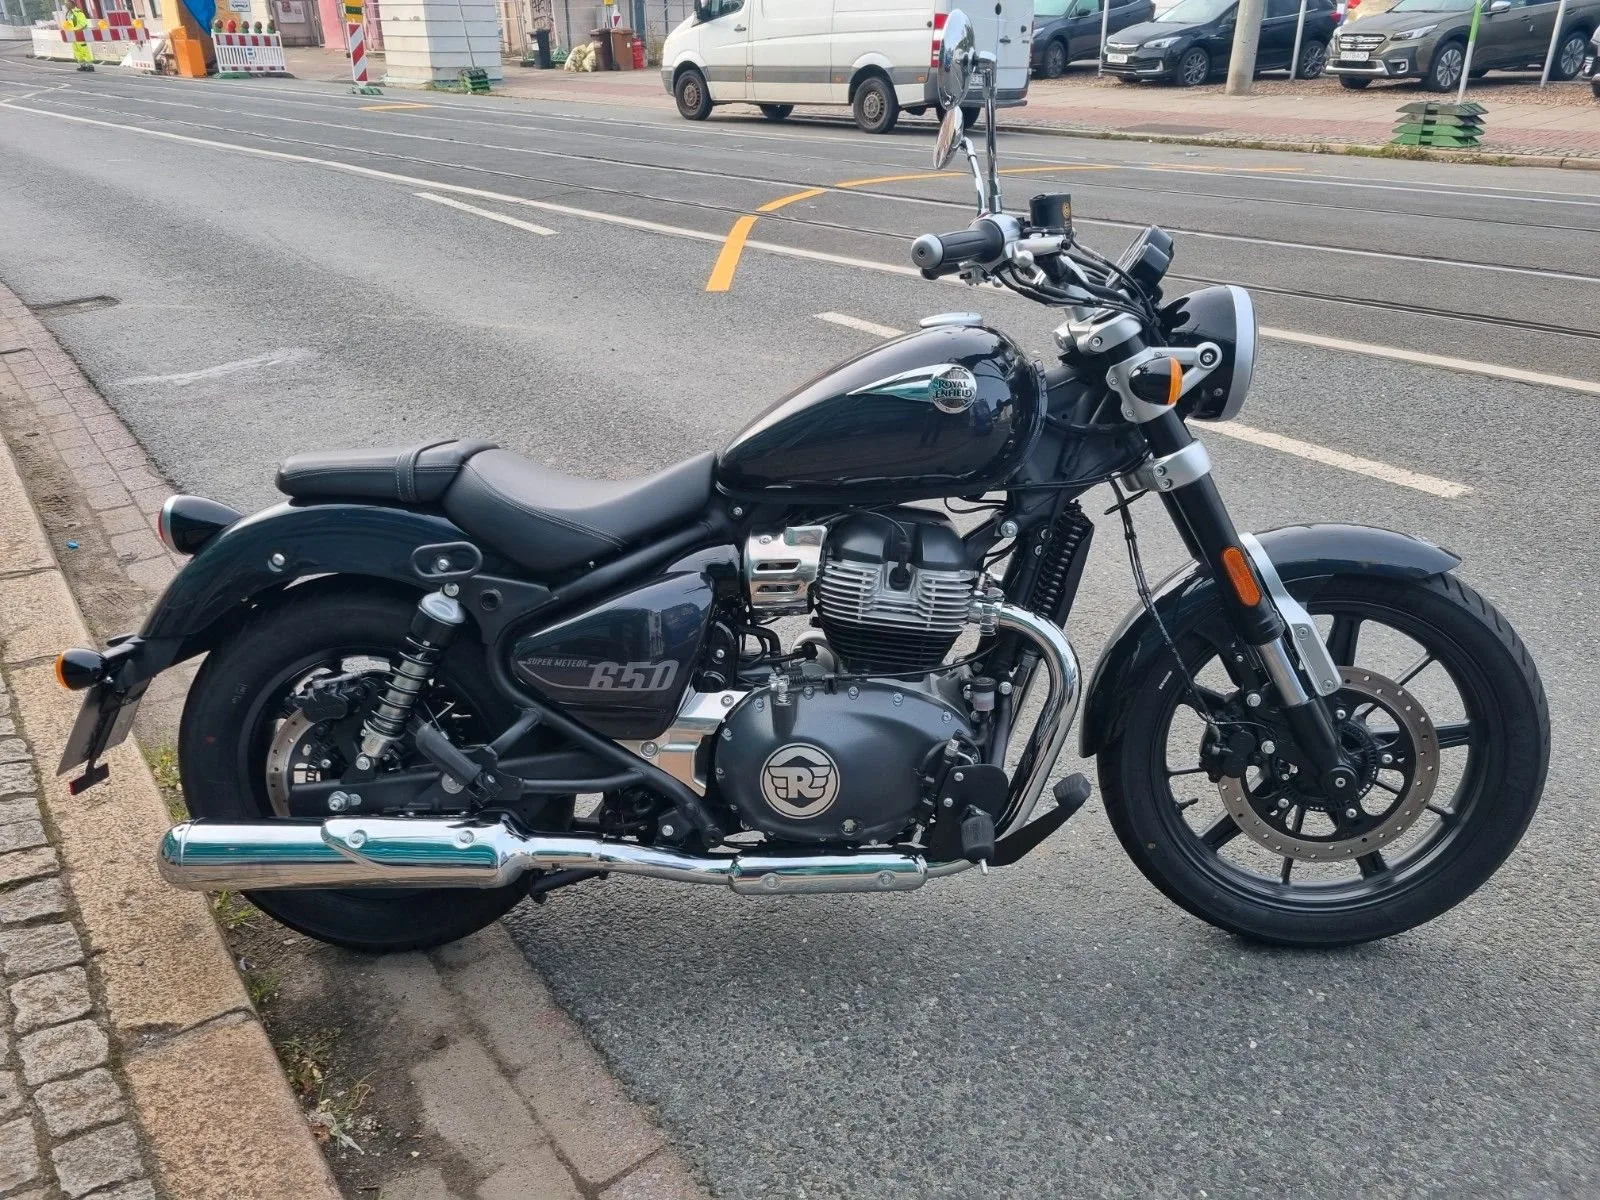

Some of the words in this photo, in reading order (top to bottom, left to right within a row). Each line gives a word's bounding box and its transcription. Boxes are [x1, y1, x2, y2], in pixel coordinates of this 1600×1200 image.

[938, 380, 968, 389] ROYAL
[935, 389, 972, 398] ENFIELD
[526, 658, 553, 667] SUPER
[554, 659, 589, 668] METEOR
[588, 659, 680, 691] 650
